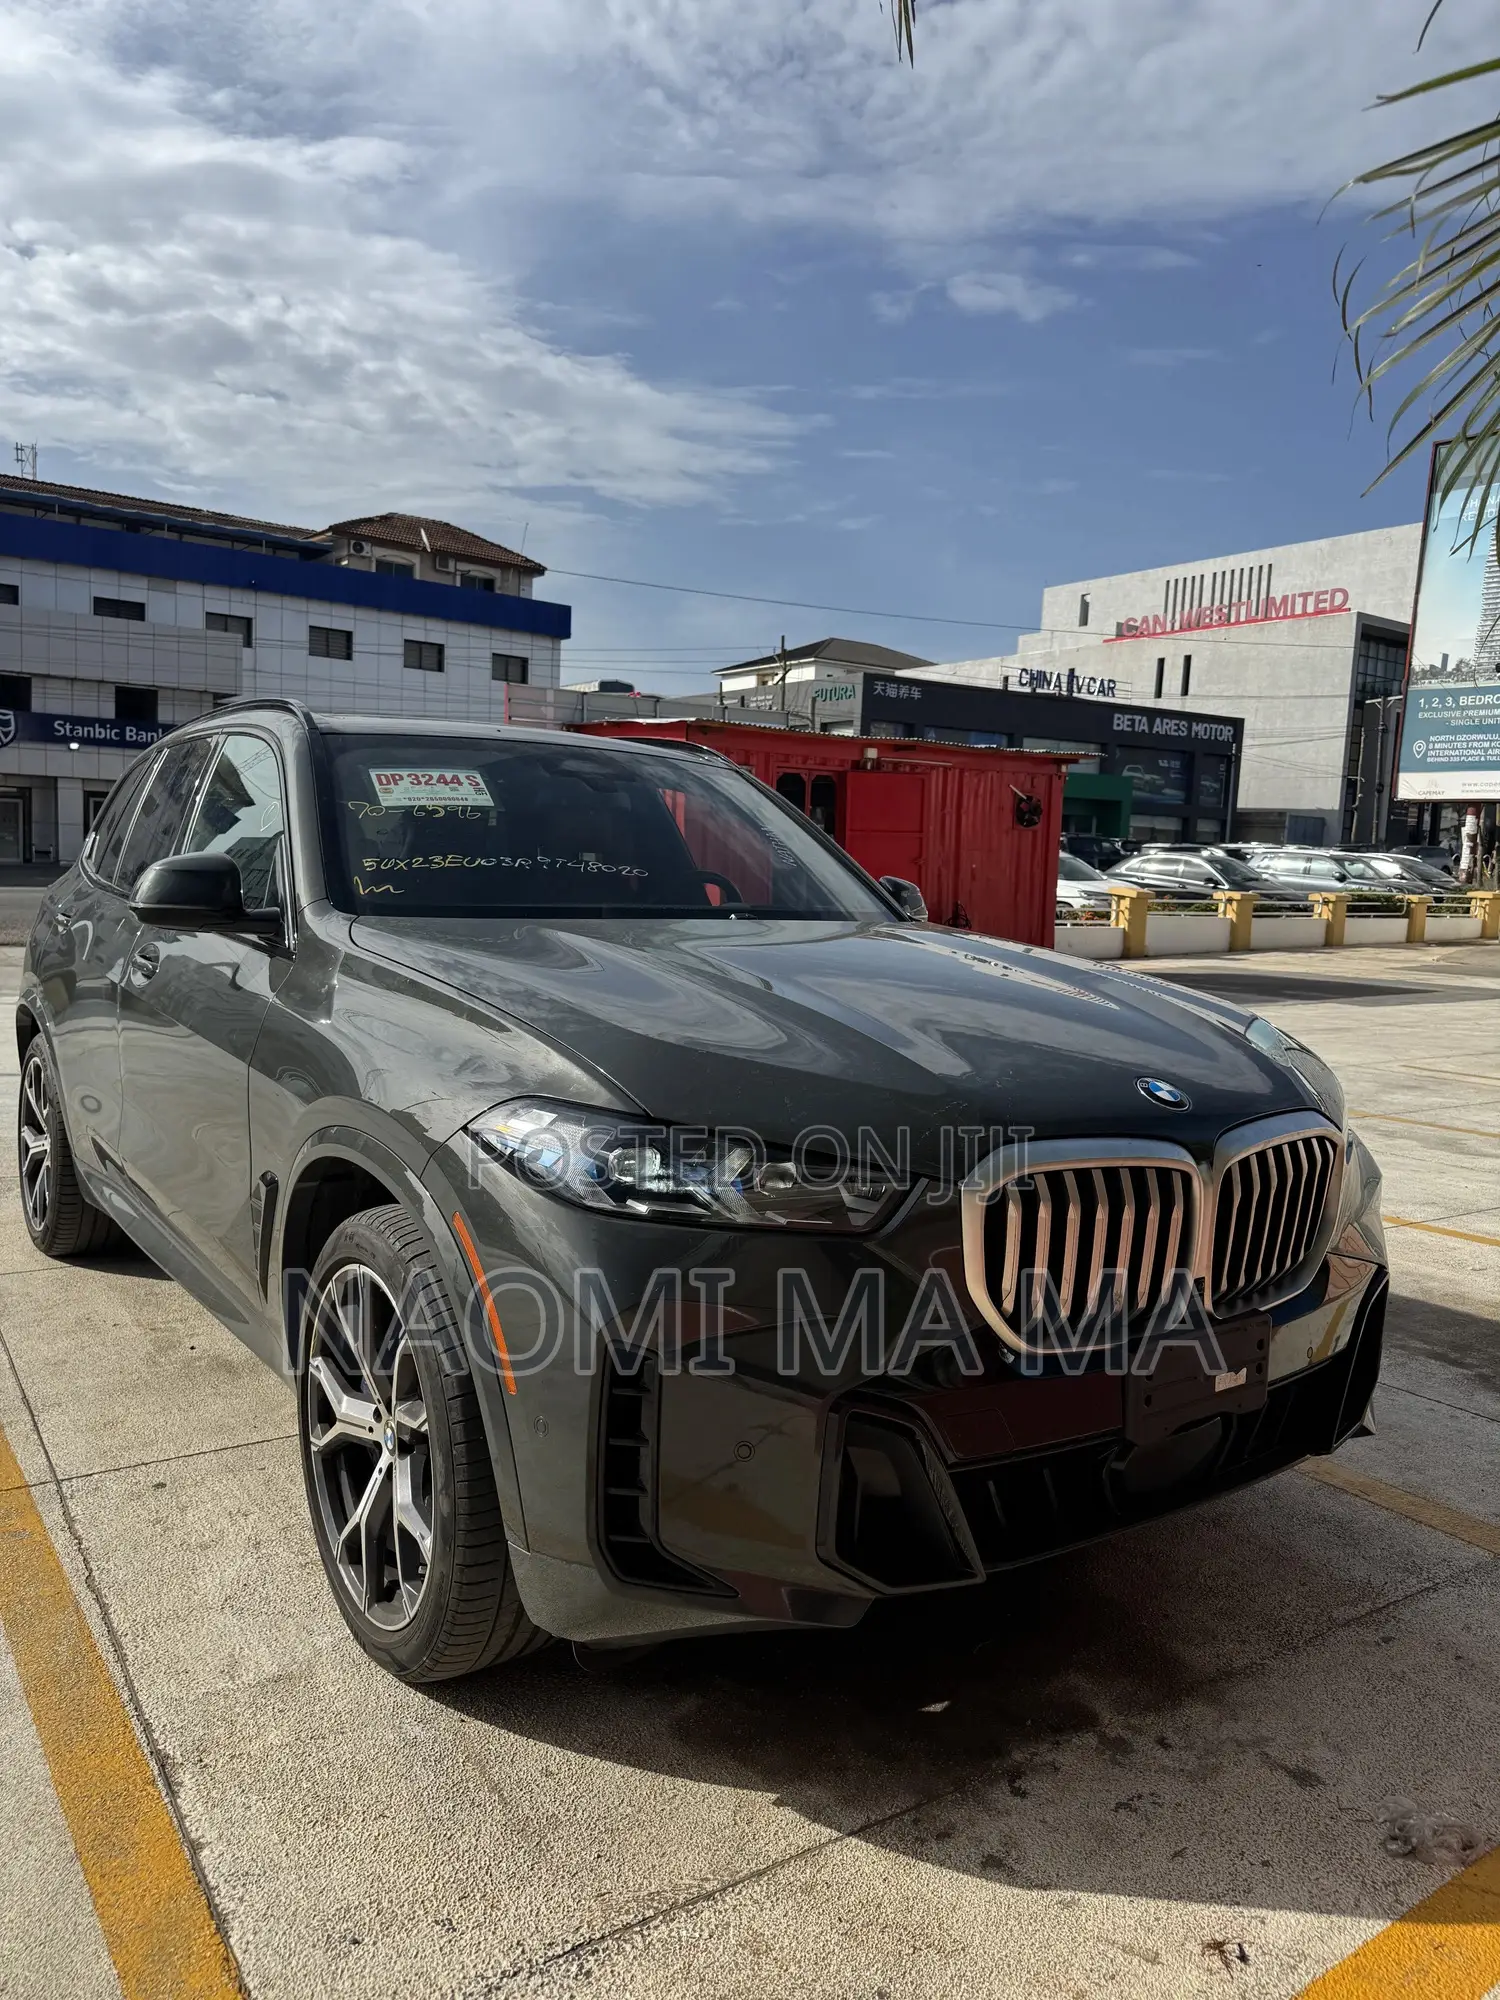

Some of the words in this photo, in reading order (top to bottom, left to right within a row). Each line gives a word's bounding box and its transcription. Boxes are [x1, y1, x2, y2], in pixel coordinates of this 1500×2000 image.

[1019, 668, 1062, 692] CHINA
[813, 685, 856, 702] FUTURA
[873, 681, 922, 700] 天猫养车
[1419, 698, 1428, 709] 1,
[1432, 697, 1442, 708] 2,
[1445, 697, 1456, 708] 3,
[1418, 710, 1461, 718] EXCLUSIVE
[1463, 709, 1500, 717] PREMIUM
[54, 720, 120, 740] Stanbic
[1113, 713, 1149, 733] BETA
[1152, 717, 1188, 737] ARES
[1191, 722, 1234, 742] MOTOR
[1427, 749, 1485, 757] INTERNATIONAL
[375, 773, 404, 787] DP
[407, 773, 464, 787] 3244
[465, 774, 481, 787] S
